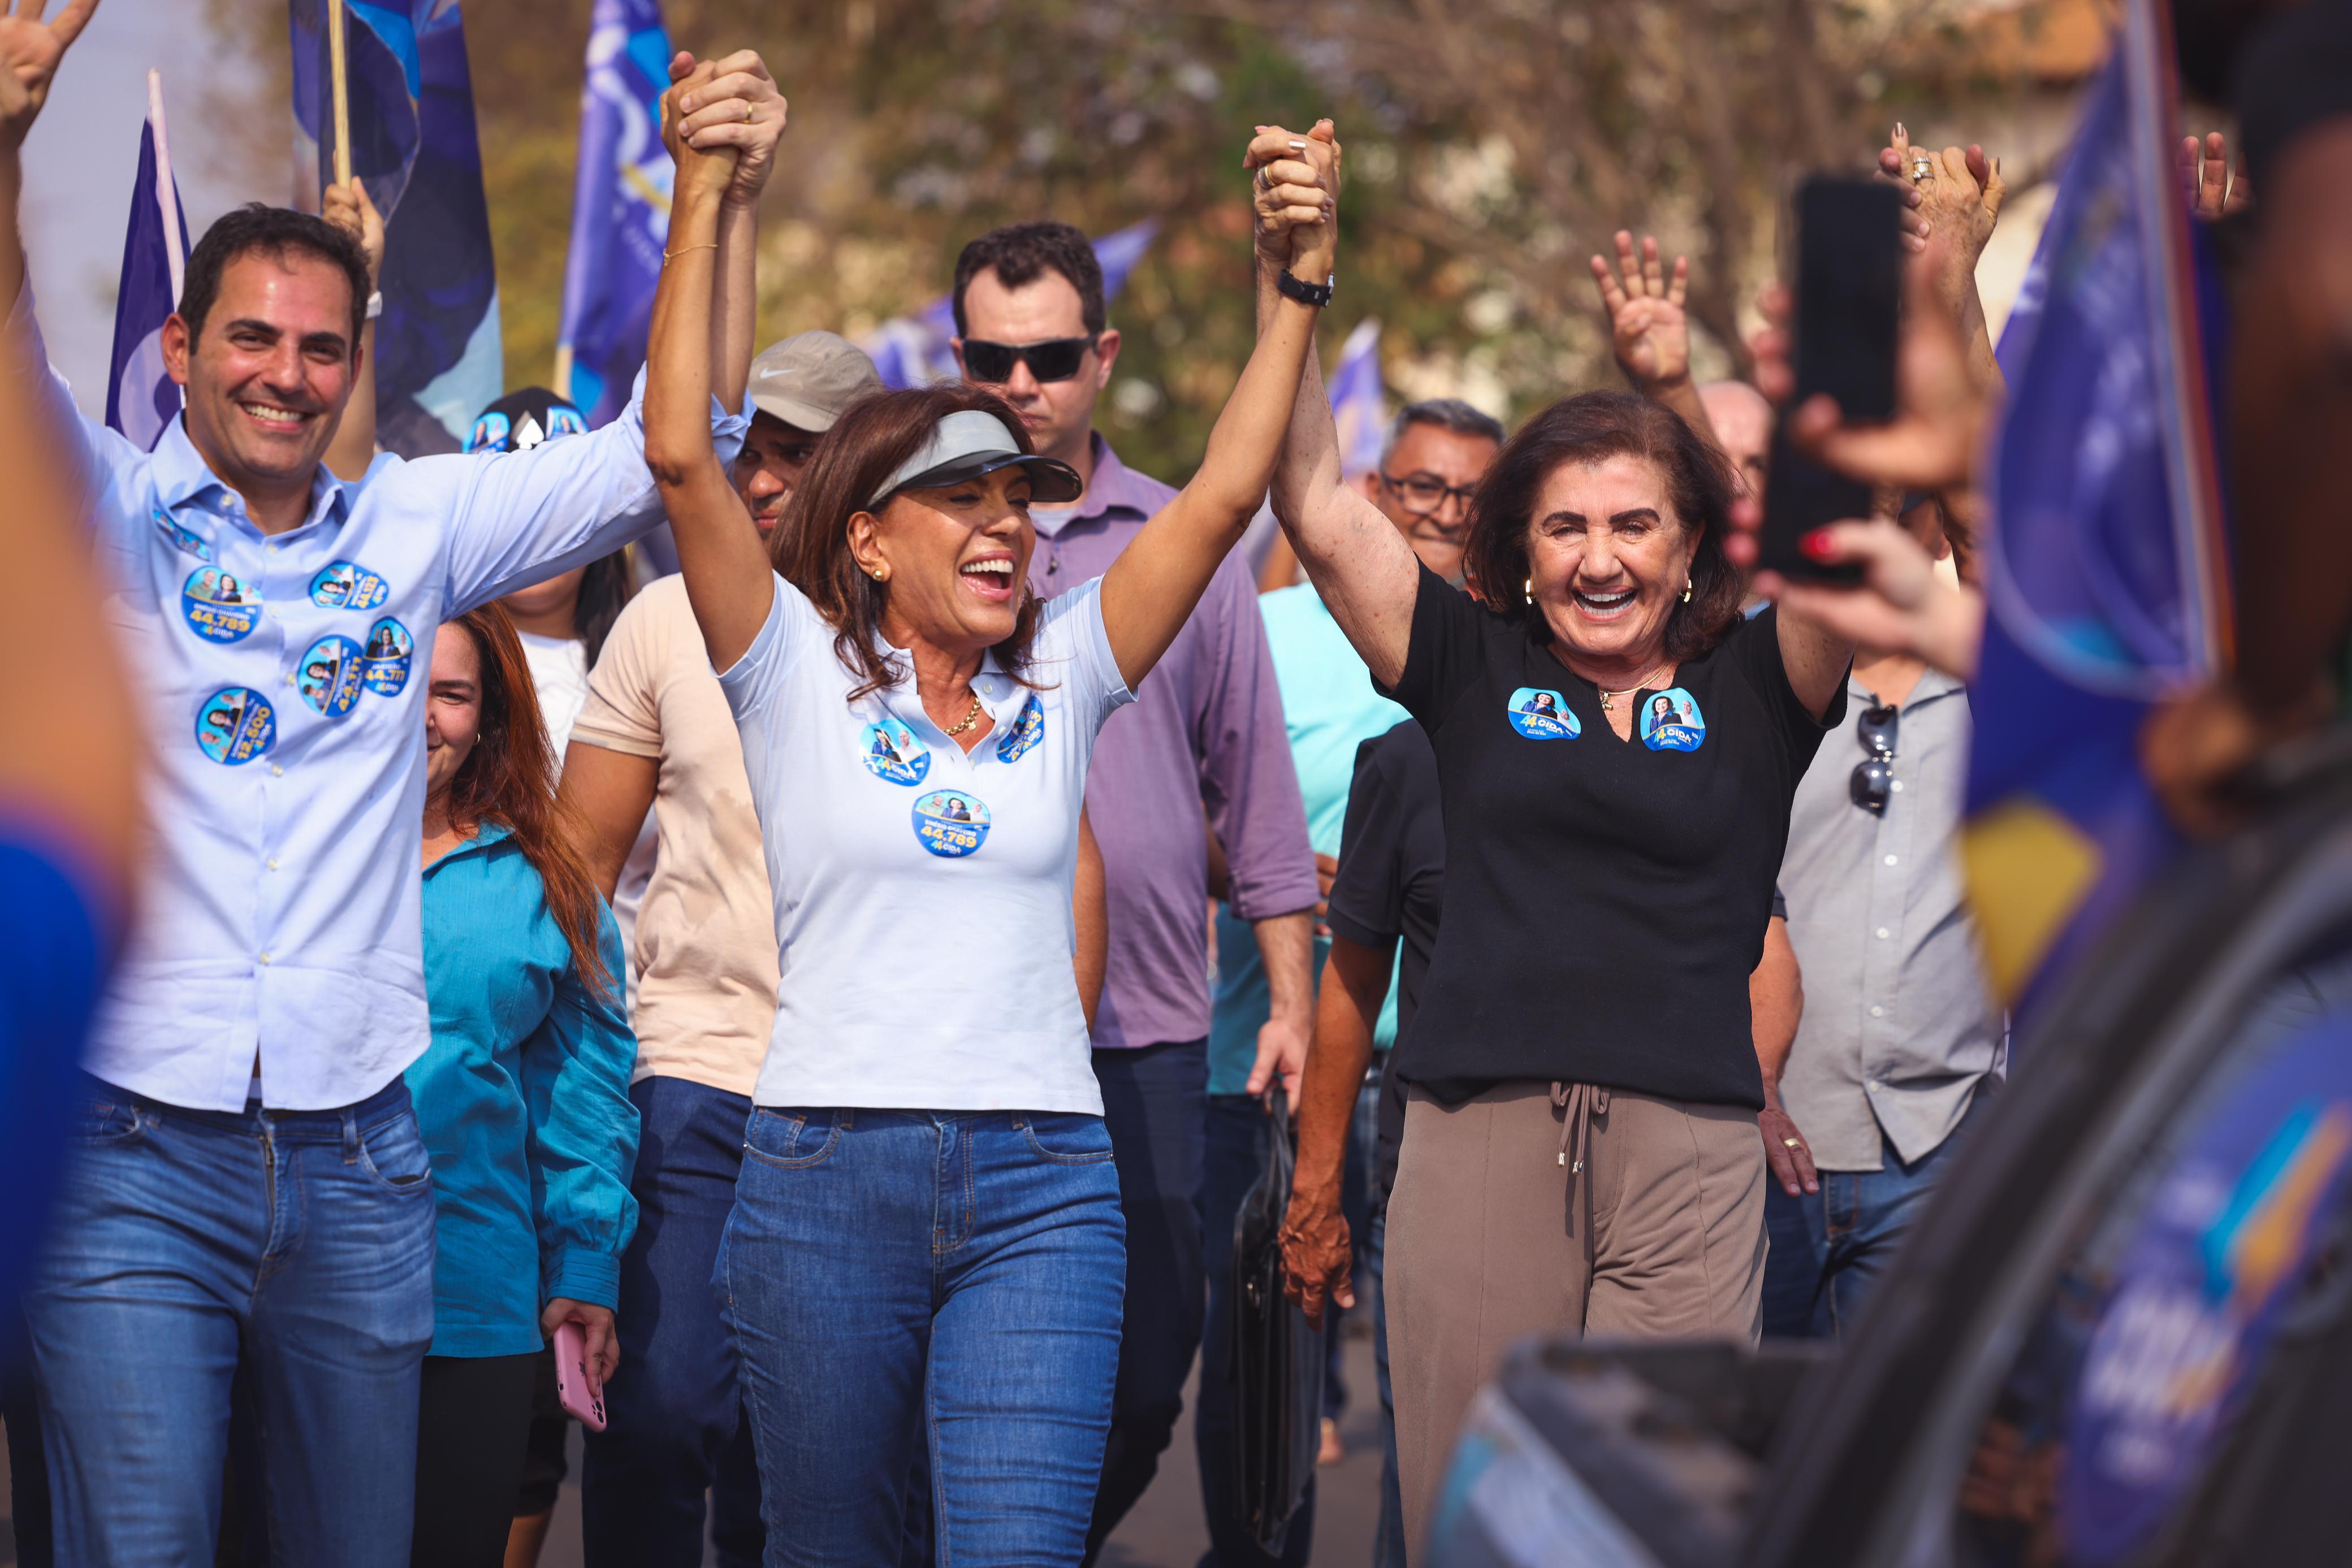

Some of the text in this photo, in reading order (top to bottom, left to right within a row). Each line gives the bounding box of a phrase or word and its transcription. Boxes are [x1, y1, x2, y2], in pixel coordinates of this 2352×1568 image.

[189, 610, 250, 632] 44.789
[1520, 714, 1537, 727] 44
[1538, 720, 1564, 736] CIDA
[1654, 727, 1666, 743] 44
[1667, 729, 1692, 743] CIDA
[920, 825, 977, 848] 44.789
